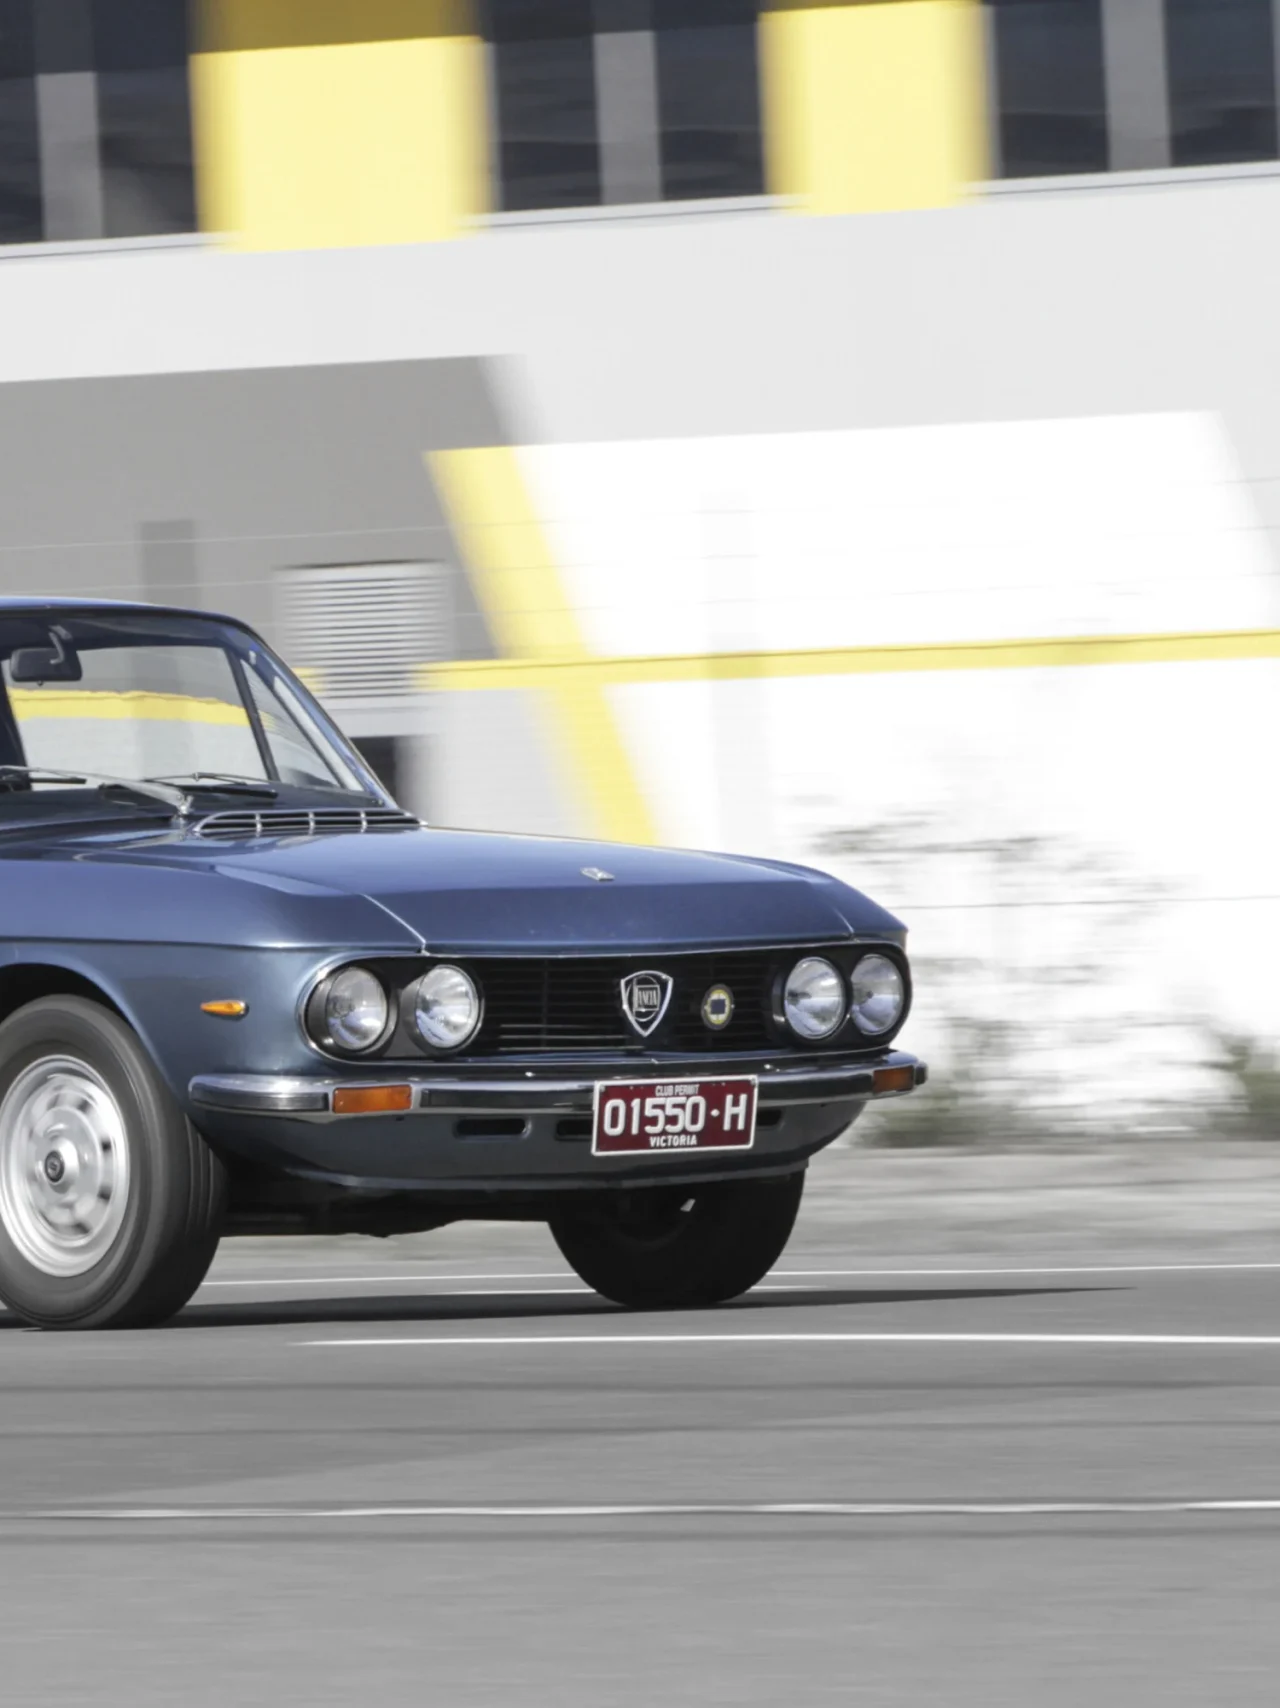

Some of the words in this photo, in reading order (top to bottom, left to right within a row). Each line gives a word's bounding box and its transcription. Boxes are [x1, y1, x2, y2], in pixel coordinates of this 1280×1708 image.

[655, 1085, 674, 1097] CLUB
[675, 1084, 700, 1096] PERMIT
[650, 1135, 697, 1147] VICTORIA
